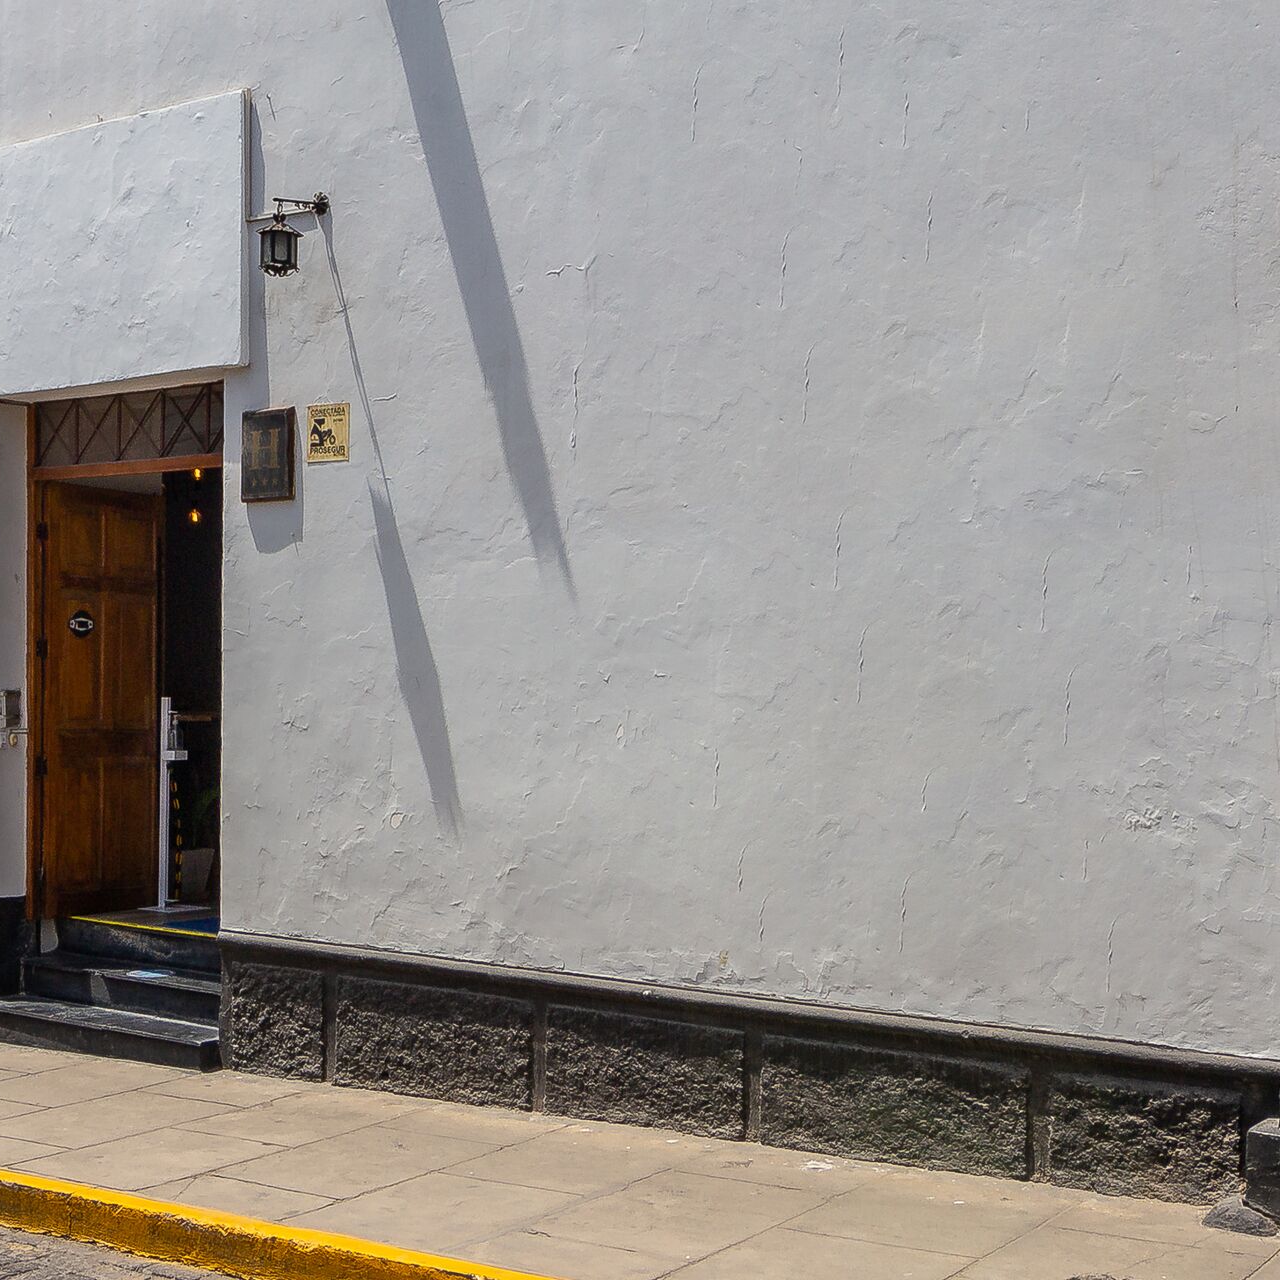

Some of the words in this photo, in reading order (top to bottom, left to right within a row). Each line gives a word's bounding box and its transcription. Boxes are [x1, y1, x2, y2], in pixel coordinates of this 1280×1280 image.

[310, 407, 346, 417] CONECTADA
[248, 428, 281, 469] H
[310, 445, 346, 455] PROSEGUR
